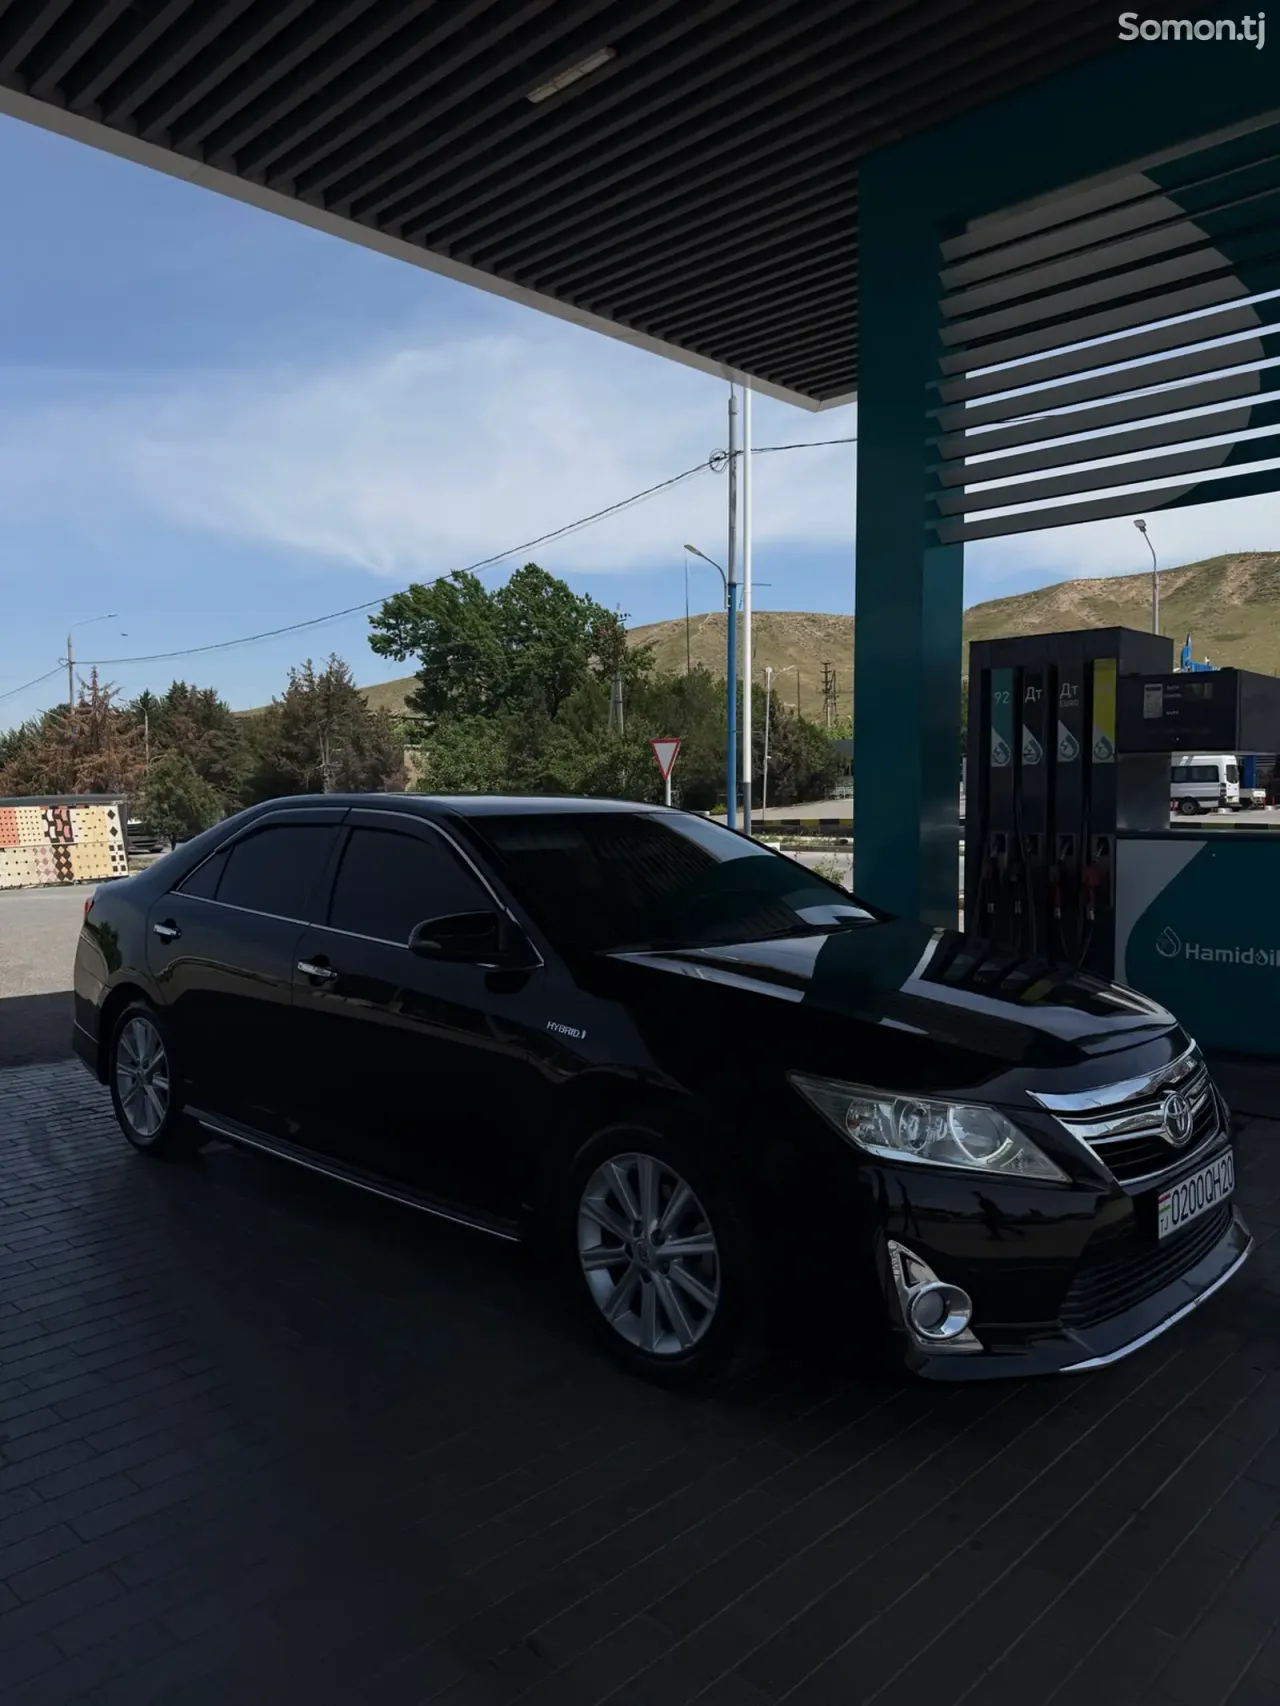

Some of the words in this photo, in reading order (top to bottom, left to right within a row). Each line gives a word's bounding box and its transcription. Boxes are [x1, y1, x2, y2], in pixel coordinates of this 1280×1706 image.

[994, 691, 1010, 704] 92
[546, 1020, 581, 1039] HYBRID
[1160, 1215, 1169, 1233] TJ
